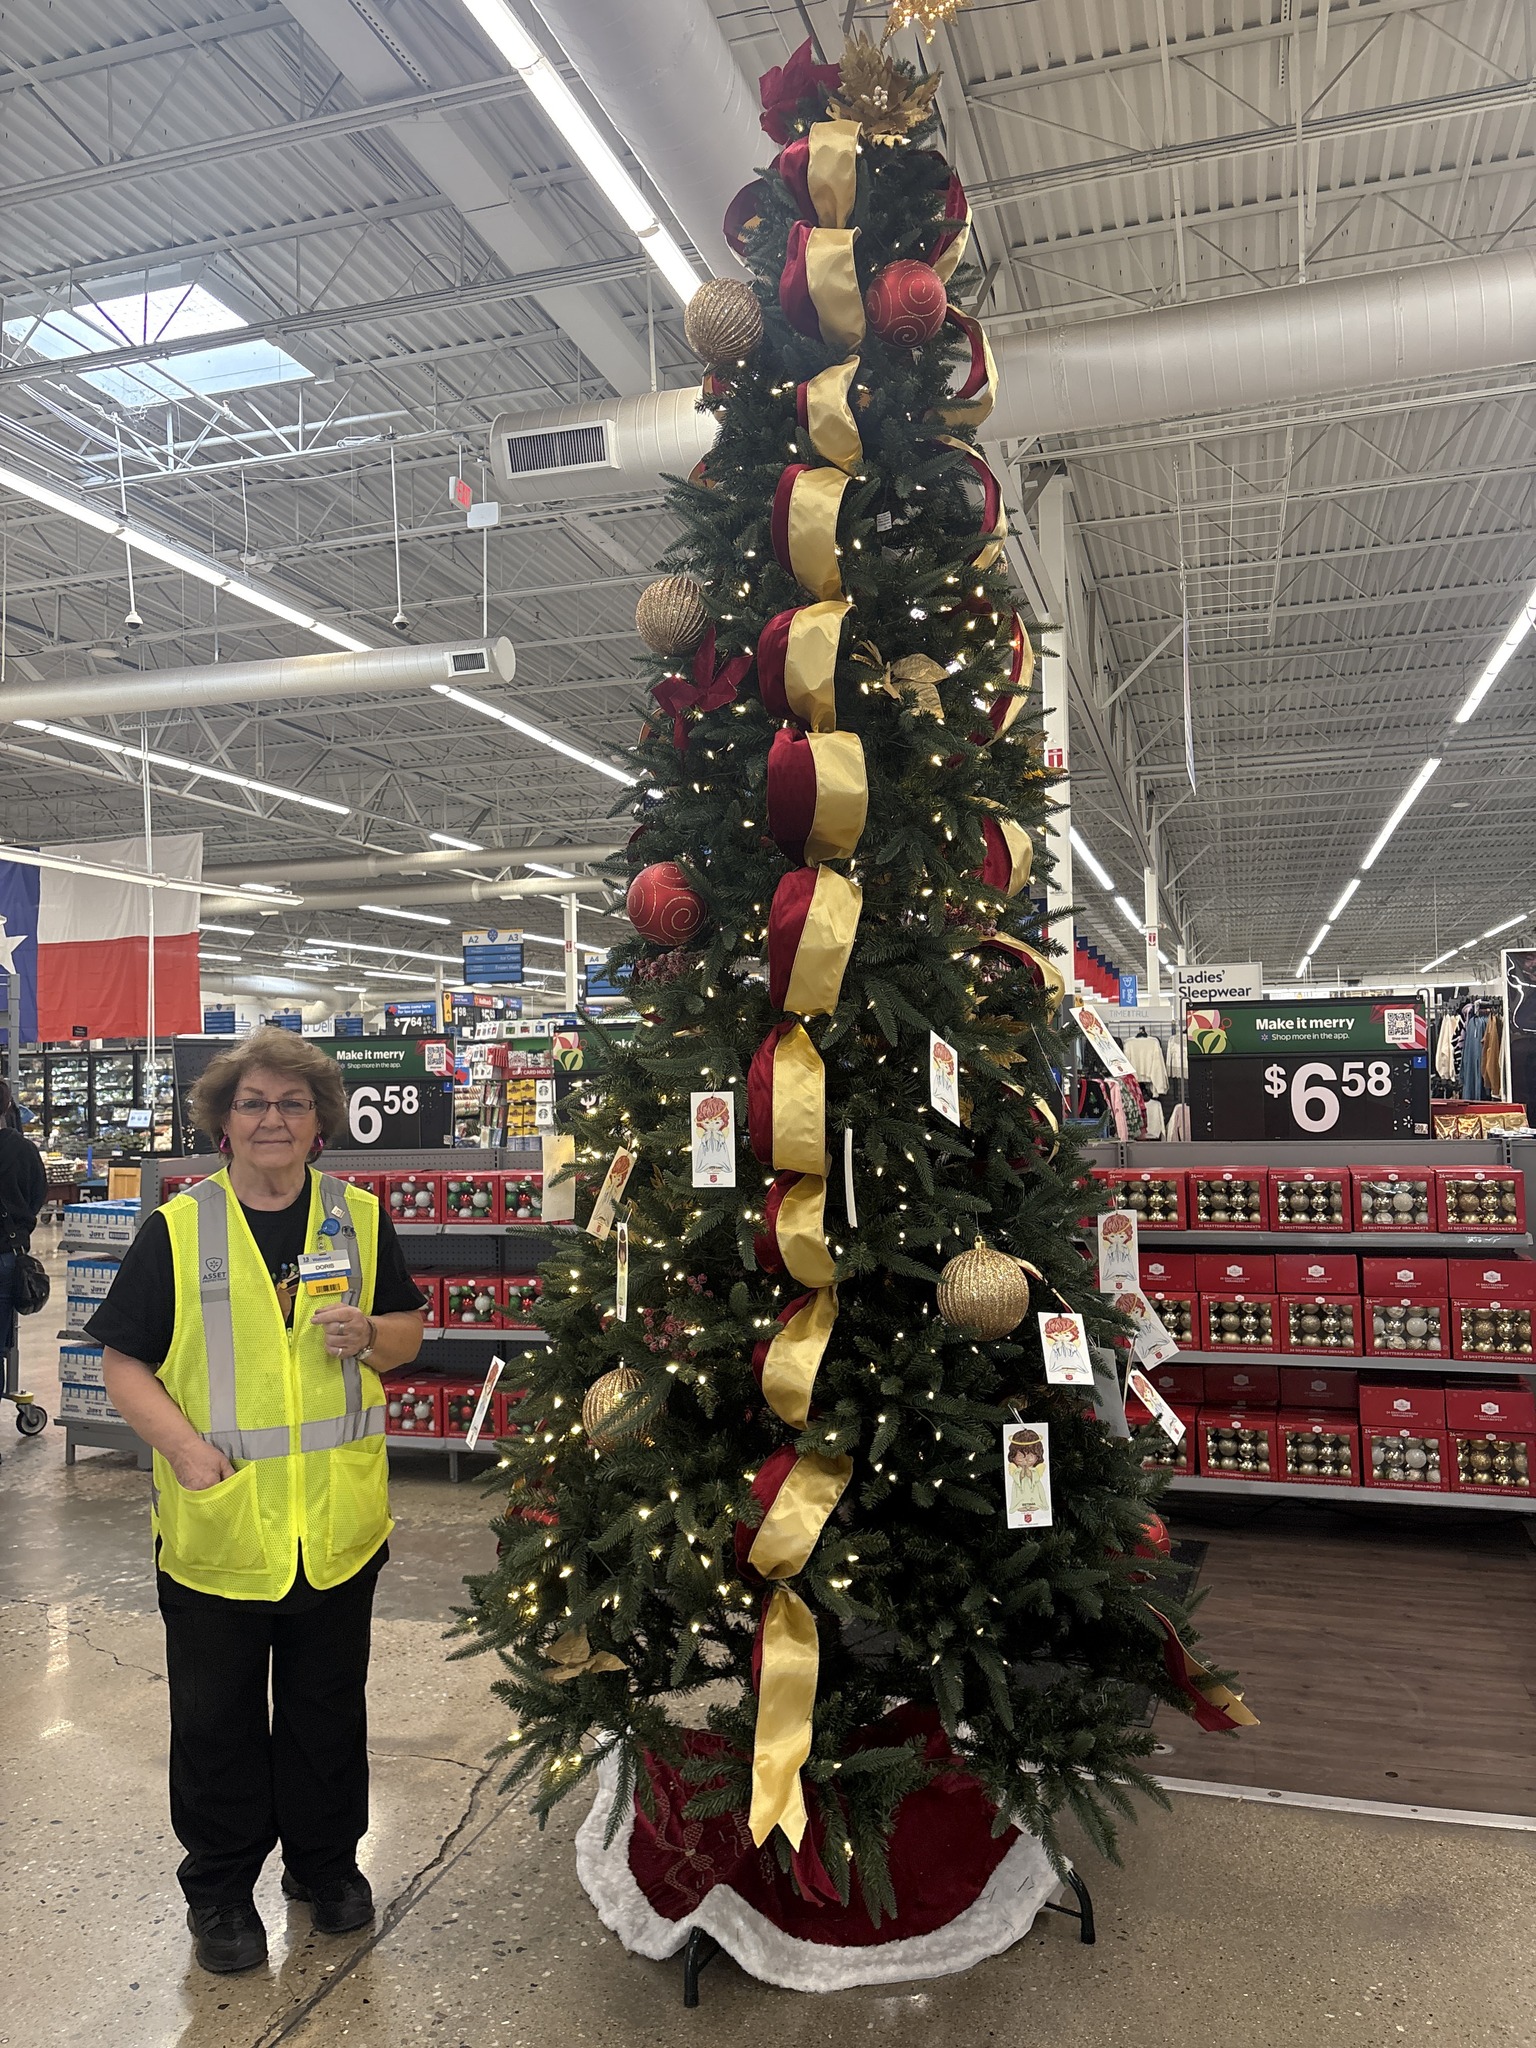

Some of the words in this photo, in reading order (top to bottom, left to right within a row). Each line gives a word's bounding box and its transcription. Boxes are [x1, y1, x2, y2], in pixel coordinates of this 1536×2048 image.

[468, 936, 479, 944] A2
[508, 934, 519, 942] A3
[1178, 986, 1252, 1002] Sleepwear
[313, 1018, 332, 1032] Deli
[1255, 1018, 1295, 1030] Make
[1296, 1017, 1307, 1029] it
[1309, 1018, 1355, 1030] merry
[1271, 1033, 1291, 1041] Shop
[336, 1050, 364, 1060] Make
[364, 1050, 372, 1060] it
[376, 1051, 405, 1061] merry
[202, 1272, 227, 1280] ASSET
